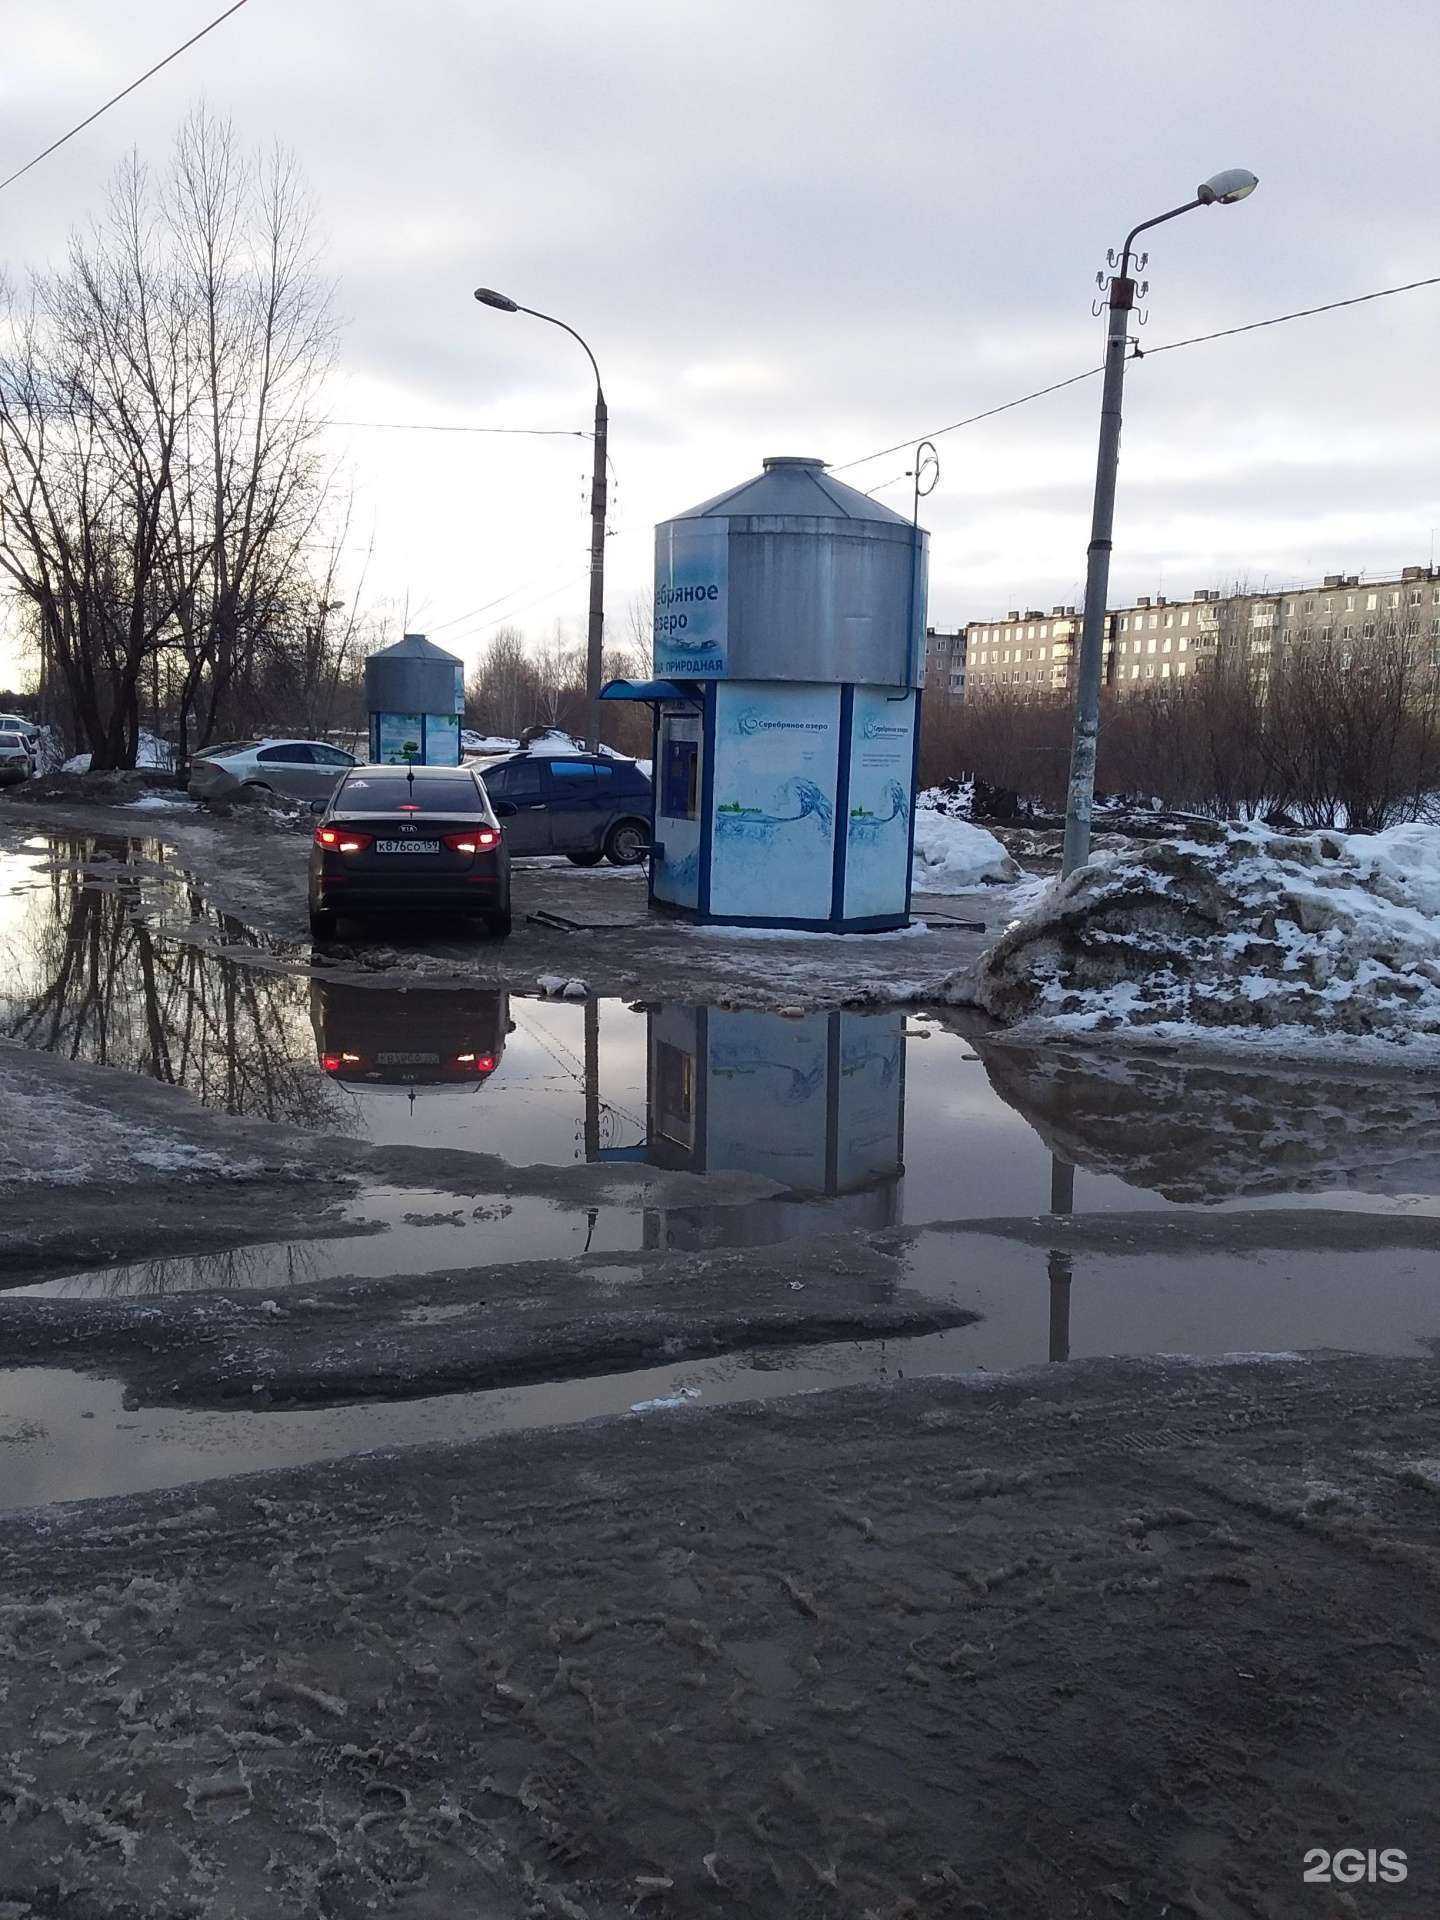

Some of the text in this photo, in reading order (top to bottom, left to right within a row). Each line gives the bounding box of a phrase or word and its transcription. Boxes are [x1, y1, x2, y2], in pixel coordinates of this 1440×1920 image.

[655, 584, 719, 608] ебряное
[665, 659, 723, 672] ПРИРОДНАЯ
[758, 720, 829, 731] Серебряное озеро
